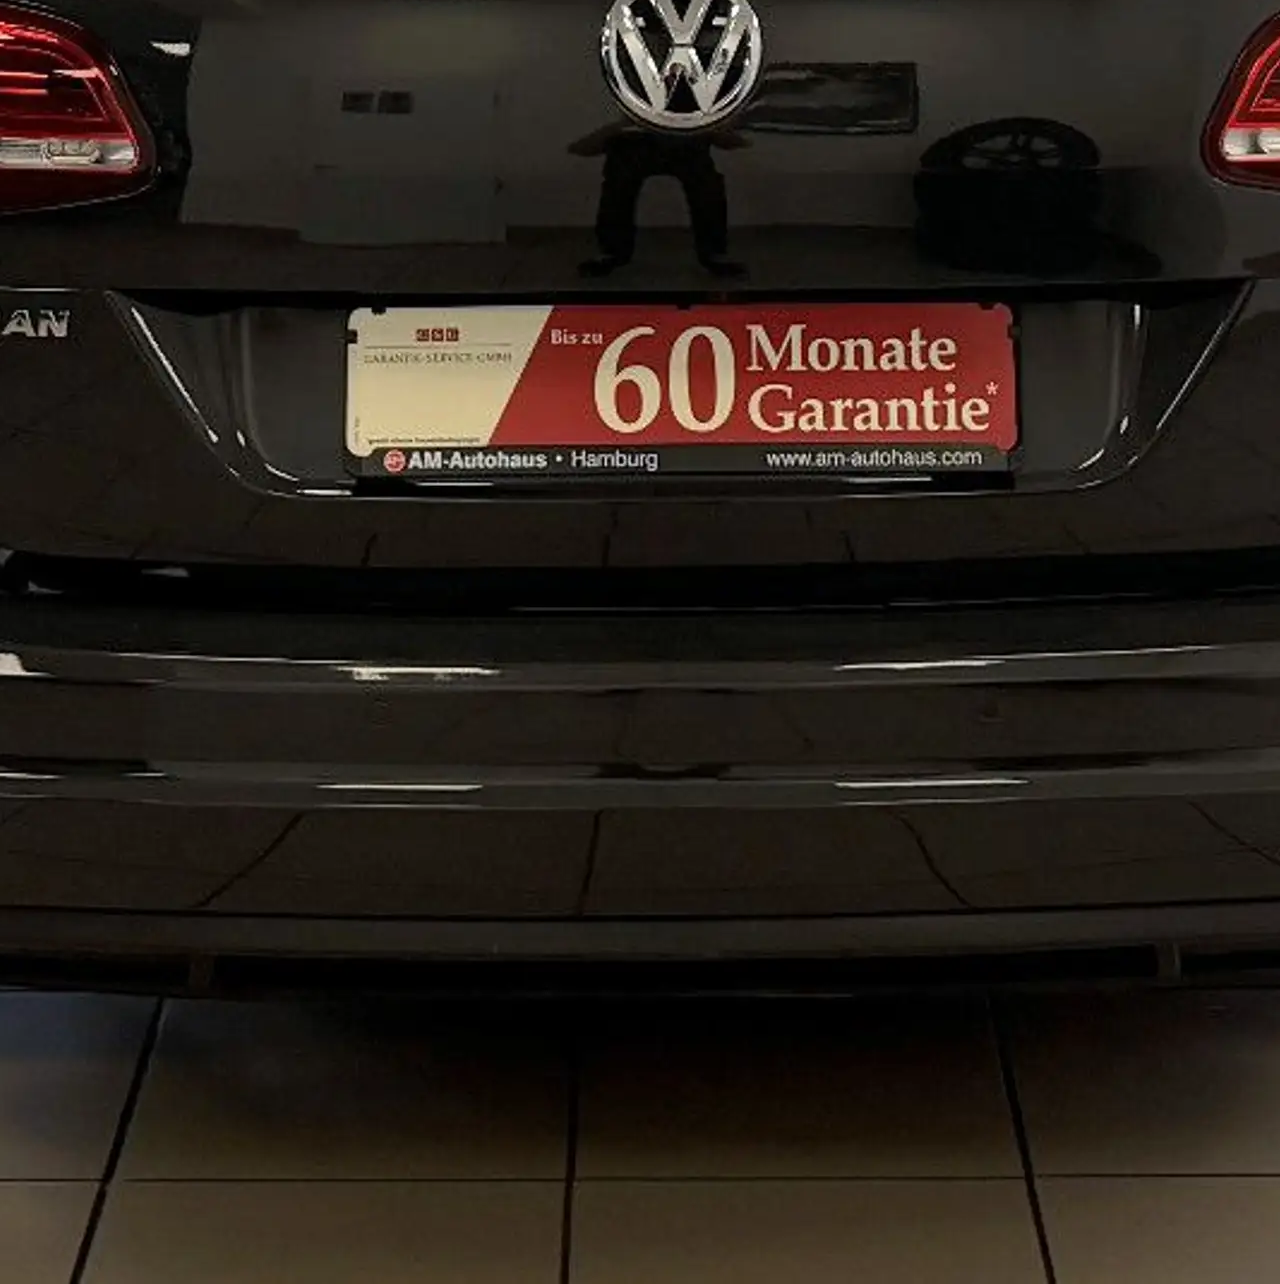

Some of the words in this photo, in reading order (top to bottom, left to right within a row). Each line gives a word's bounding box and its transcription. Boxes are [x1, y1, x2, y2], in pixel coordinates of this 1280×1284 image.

[550, 329, 578, 345] Bis
[581, 332, 604, 345] zu
[746, 324, 958, 372] Monate
[594, 326, 735, 434] 60
[408, 450, 548, 469] AM-Autohaus
[571, 450, 659, 472] Hamburg
[766, 449, 983, 467] www.am-autohaus.com
